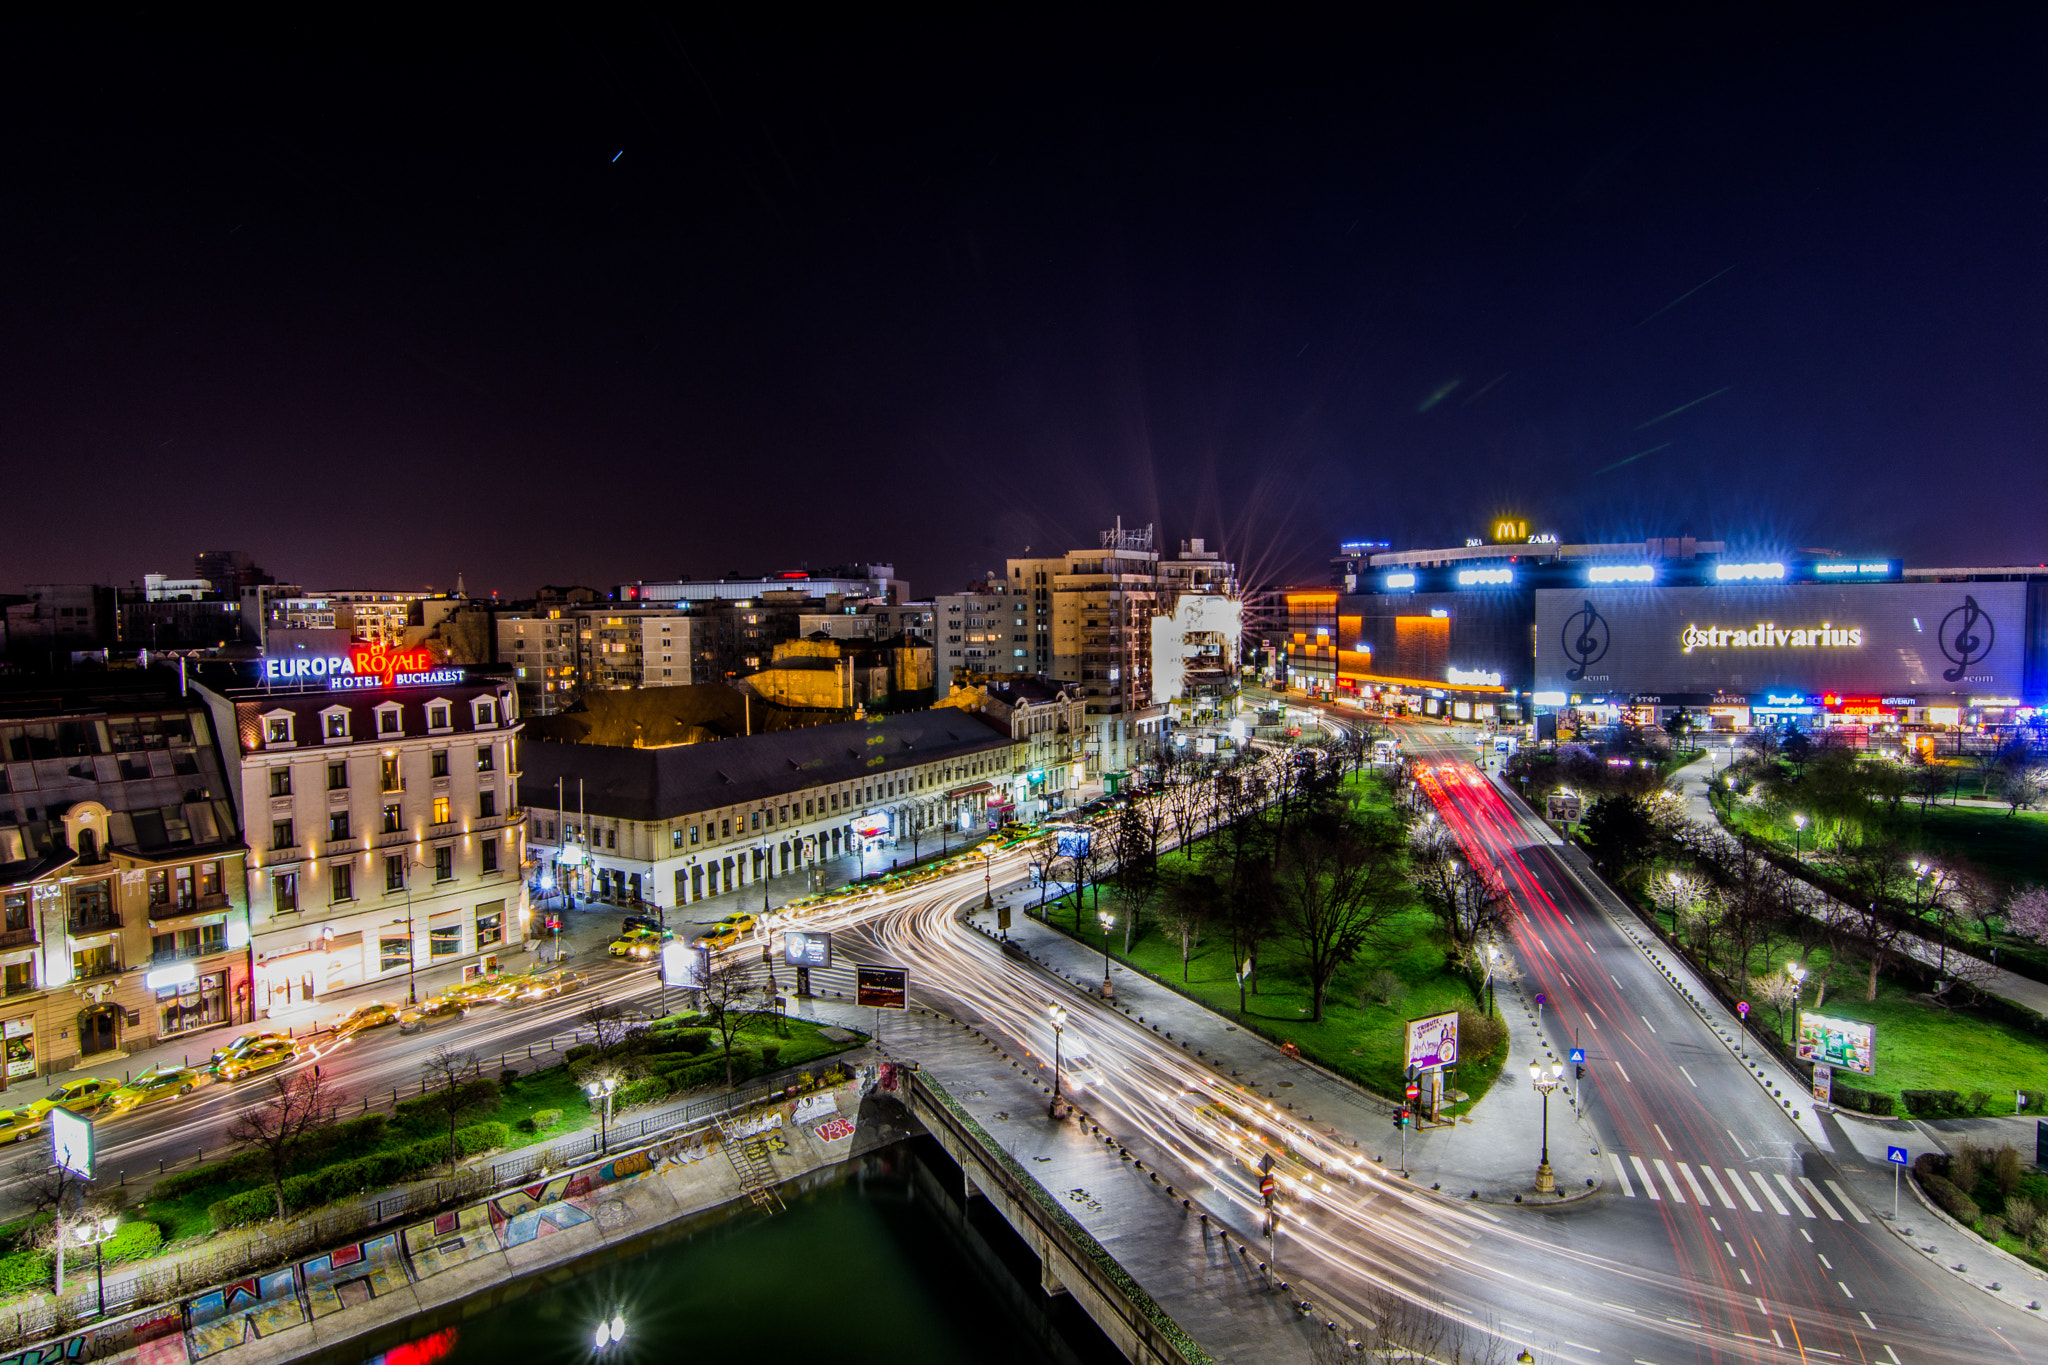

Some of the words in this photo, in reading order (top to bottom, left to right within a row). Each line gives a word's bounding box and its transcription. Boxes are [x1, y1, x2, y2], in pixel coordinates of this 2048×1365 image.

[1528, 535, 1557, 544] ZARA
[1695, 622, 1863, 648] stradivarius
[266, 657, 355, 678] EUROPA
[355, 652, 429, 685] ROYALE
[331, 675, 383, 689] HOTEL
[396, 670, 465, 685] BUCHAREST
[1713, 696, 1746, 704] KOTON
